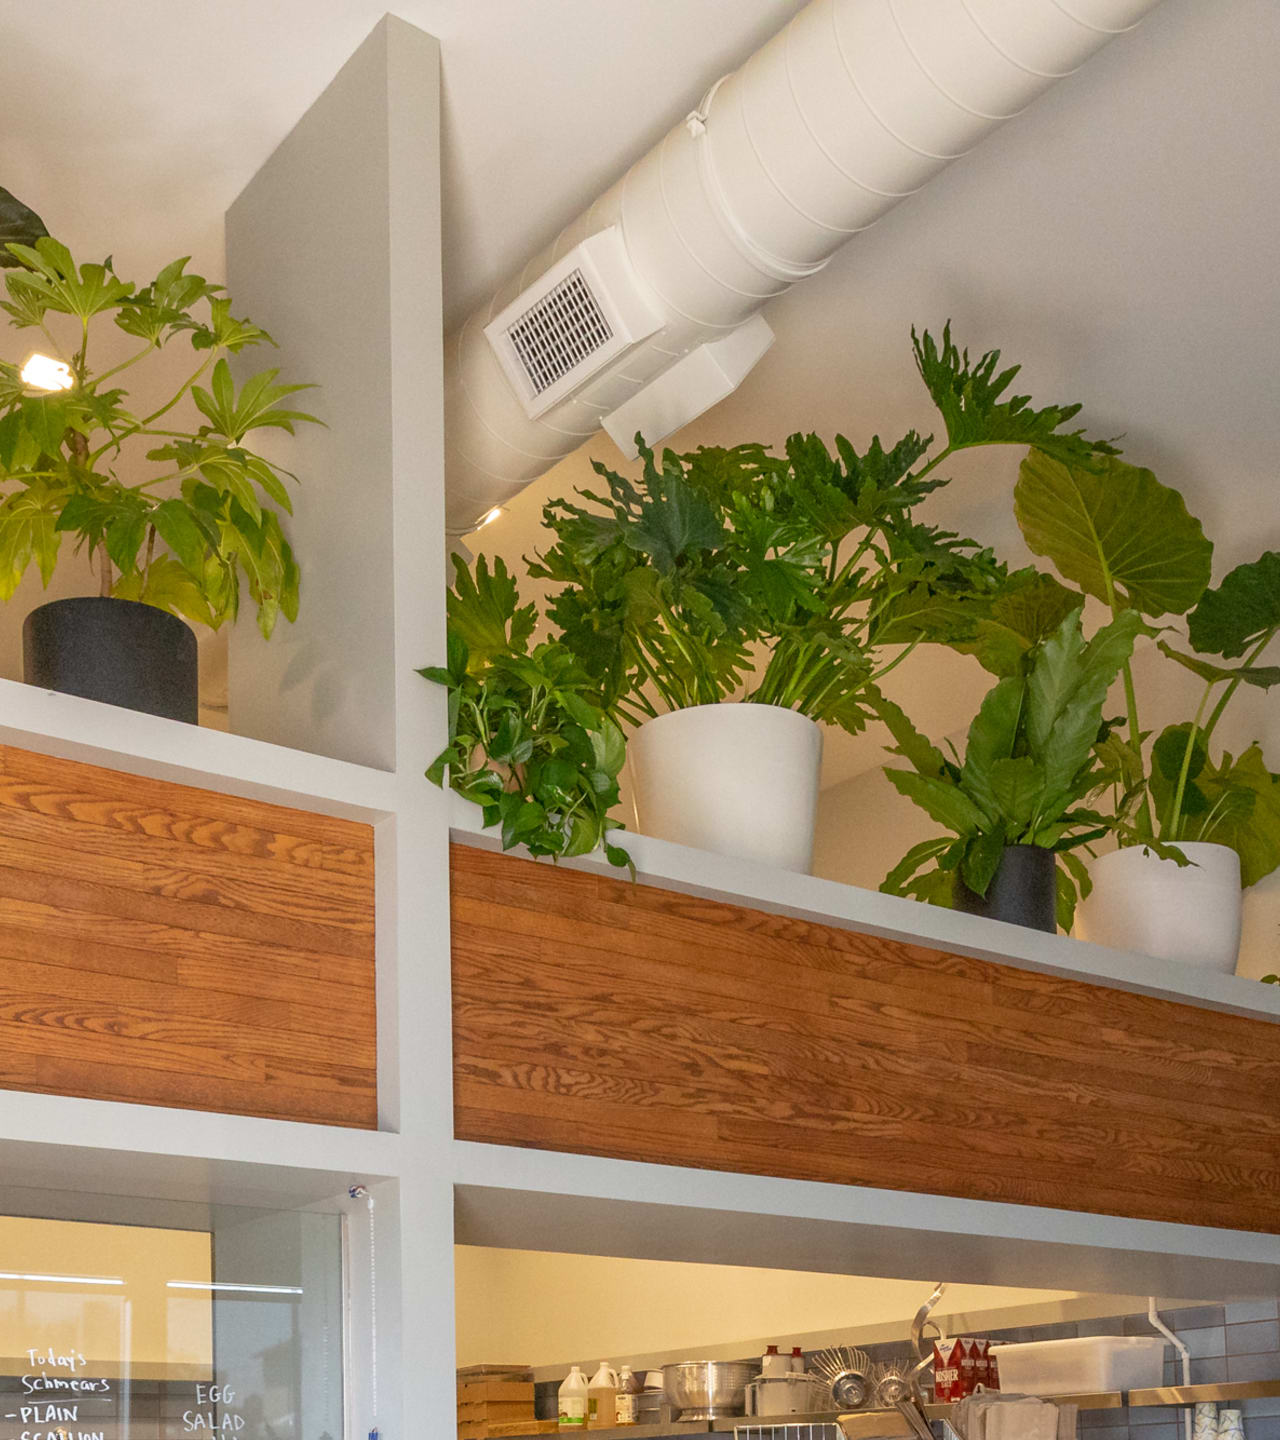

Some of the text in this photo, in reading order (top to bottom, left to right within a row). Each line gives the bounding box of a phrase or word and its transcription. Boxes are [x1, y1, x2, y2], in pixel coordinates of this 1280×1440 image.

[27, 1347, 87, 1372] Today's
[21, 1372, 110, 1394] Schmears
[195, 1384, 236, 1405] EGG
[20, 1405, 78, 1423] PLAIN
[183, 1410, 245, 1432] SALAD
